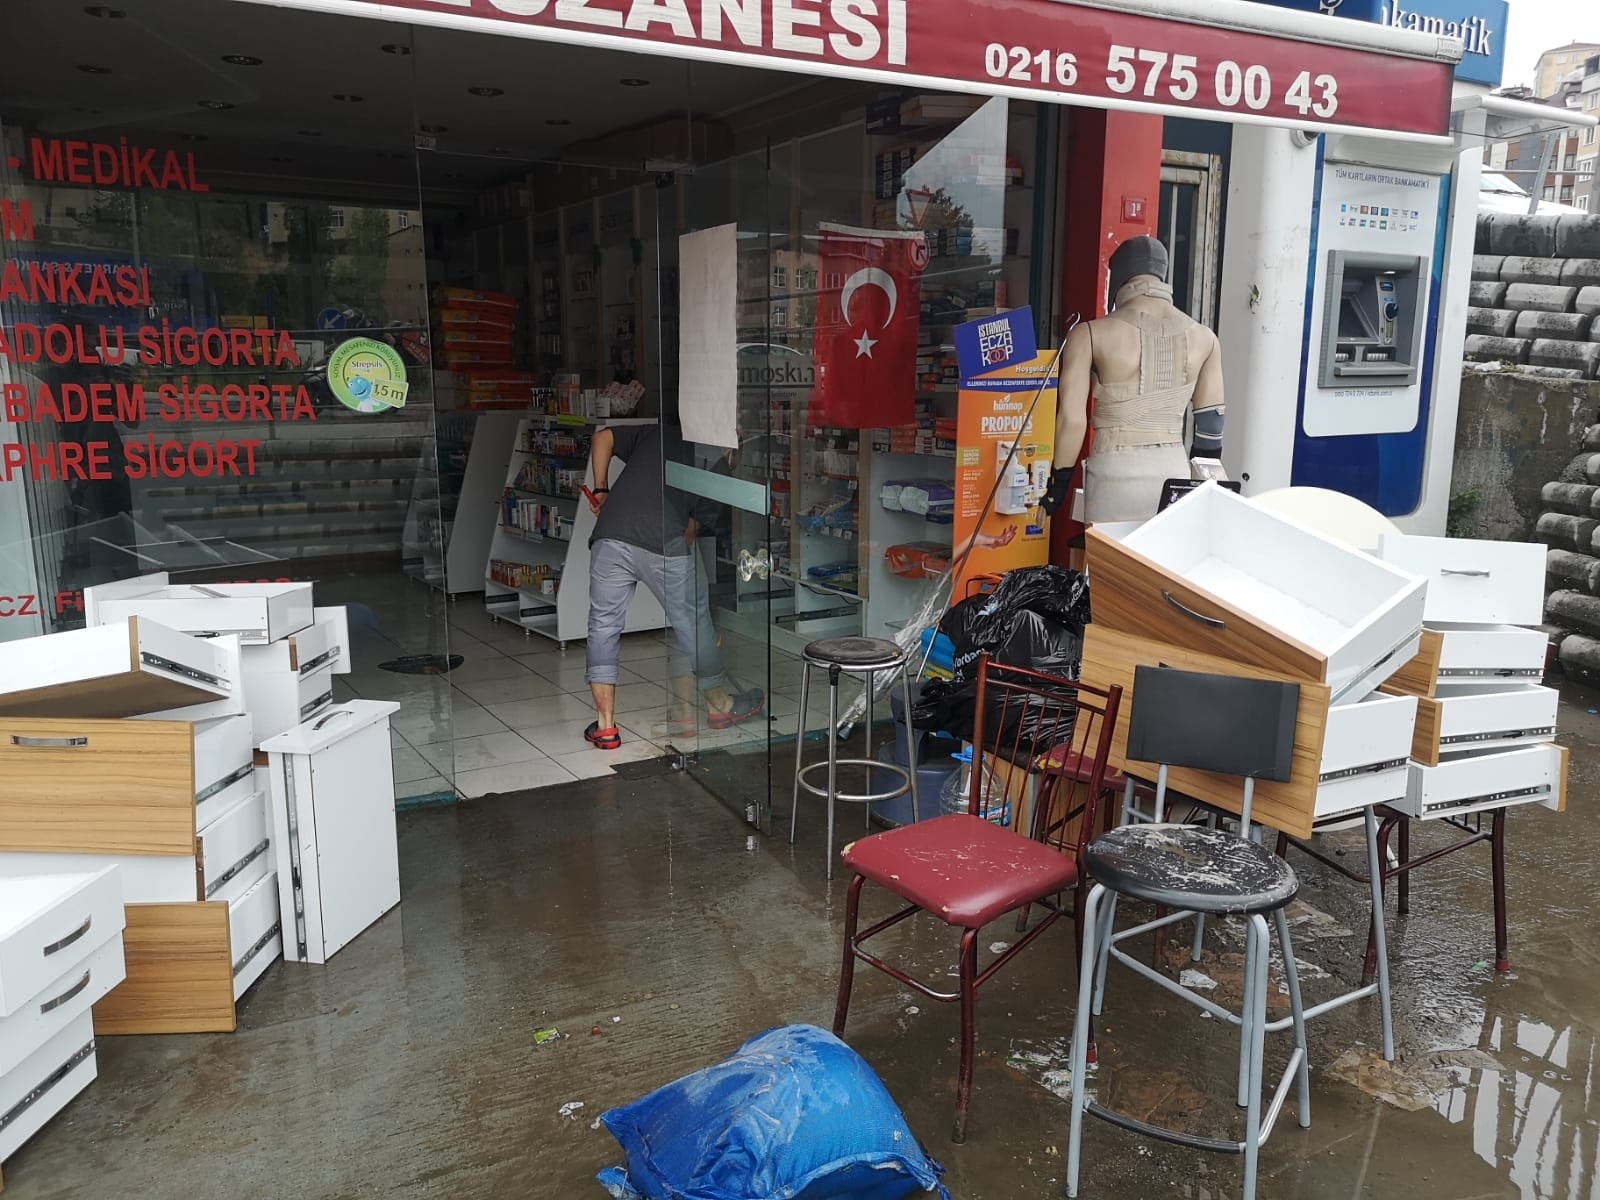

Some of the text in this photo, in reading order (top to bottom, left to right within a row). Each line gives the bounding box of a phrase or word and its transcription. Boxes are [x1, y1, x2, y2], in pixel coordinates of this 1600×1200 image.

[985, 43, 1338, 118] 0216 575 00 43
[31, 136, 210, 192] MEDİKAL
[0, 260, 151, 307] ANKASI
[138, 317, 300, 366] SİGORTA
[980, 331, 1012, 352] ECZA
[981, 345, 1013, 367] KOOP
[158, 375, 317, 422] SİGORTA
[391, 390, 404, 400] m
[0, 433, 260, 481] PHRE SİGORT
